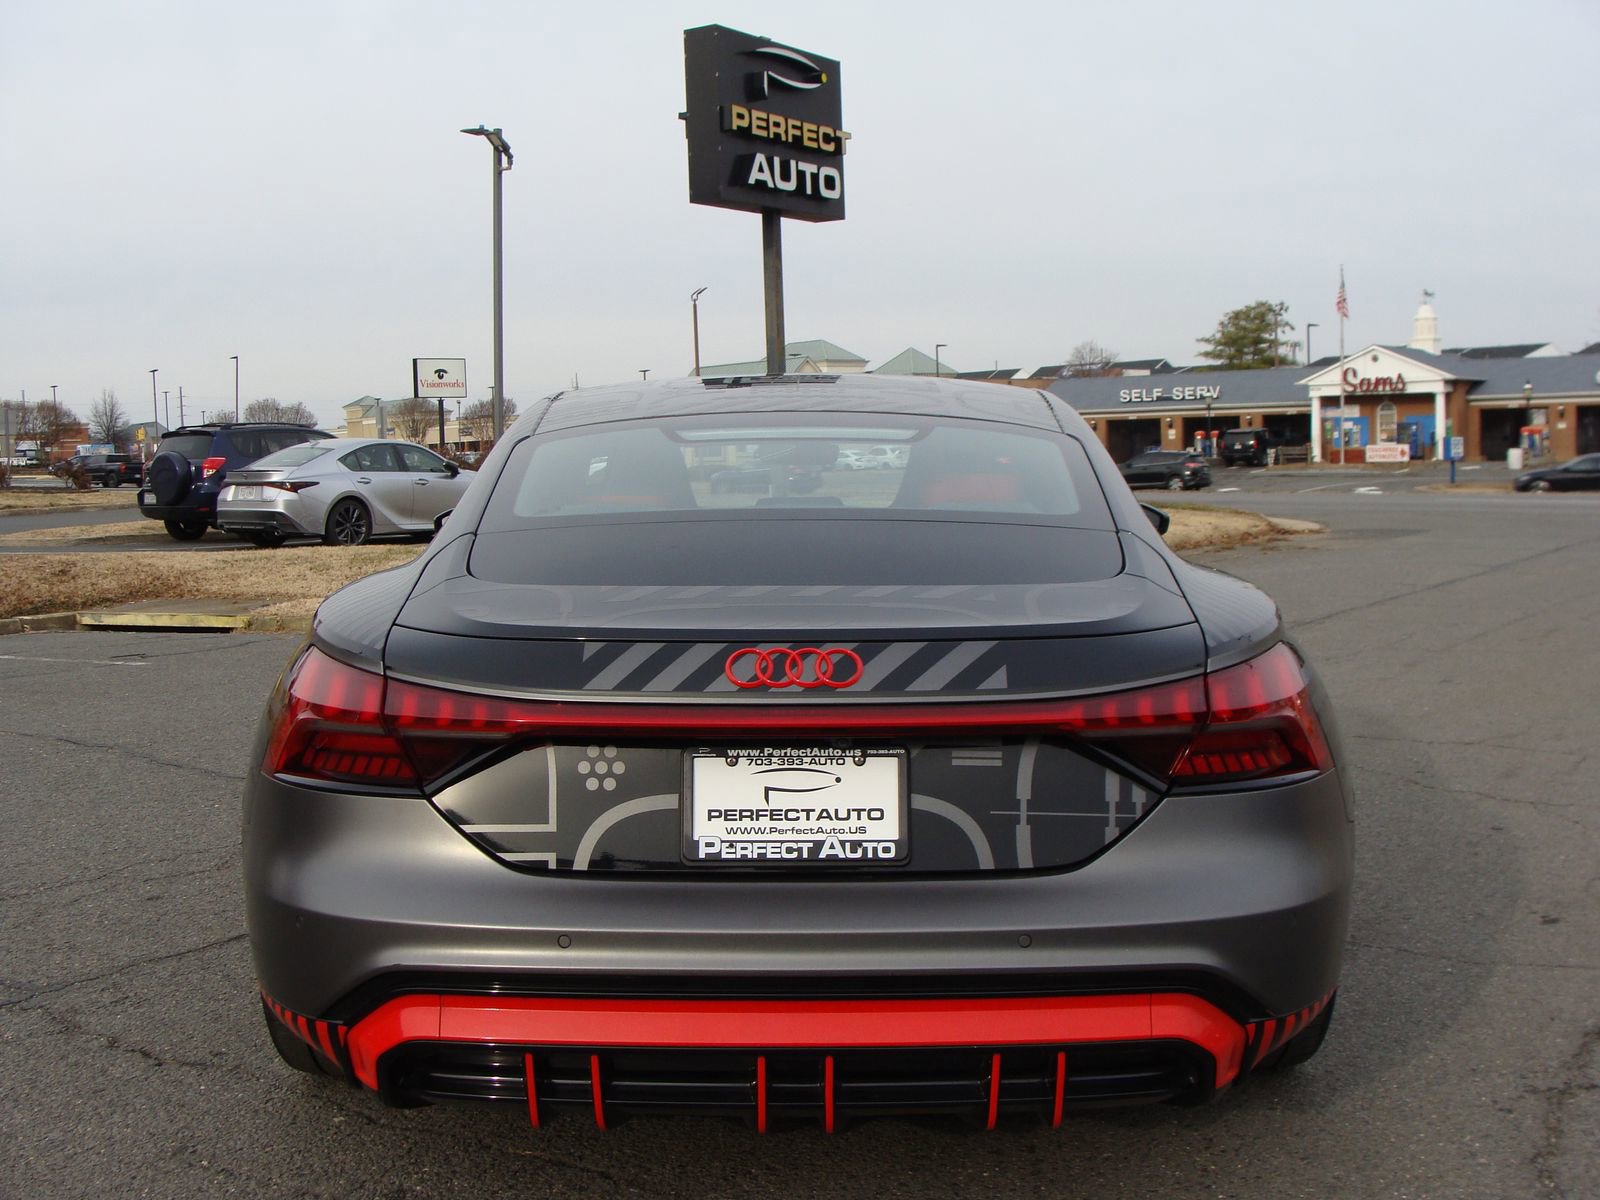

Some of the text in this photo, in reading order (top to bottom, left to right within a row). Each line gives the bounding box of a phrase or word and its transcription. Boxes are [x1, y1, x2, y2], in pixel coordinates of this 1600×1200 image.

[731, 104, 851, 155] PERFECT
[748, 152, 841, 199] AUTO
[420, 379, 464, 388] Visionworks
[1343, 367, 1406, 393] Sams
[1120, 386, 1220, 402] SELF SERV
[728, 747, 861, 757] www.PerfectAuto.us
[746, 757, 846, 766] 703-393-AUTO
[707, 808, 885, 822] PERFECTAUTO
[726, 826, 867, 835] WWW.PerfectAuto.US
[698, 836, 896, 859] PERFECT AUTO
